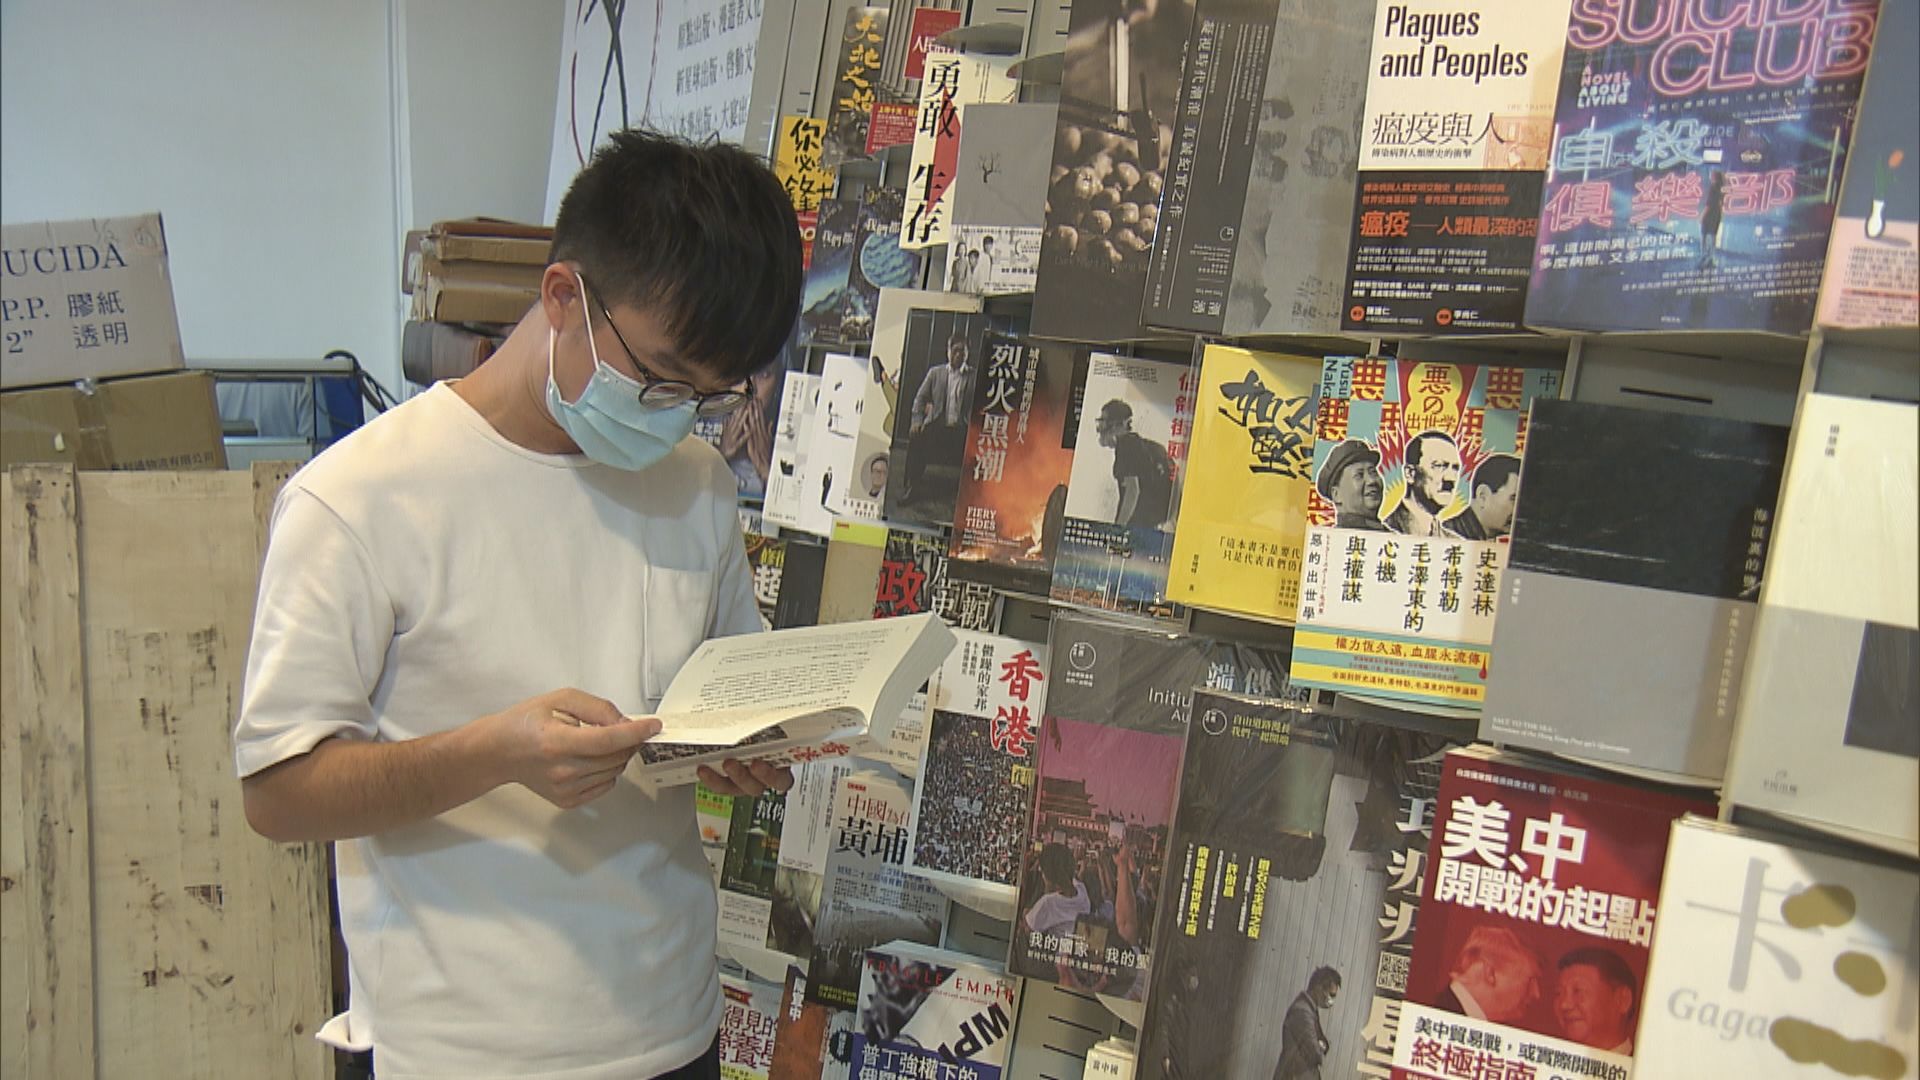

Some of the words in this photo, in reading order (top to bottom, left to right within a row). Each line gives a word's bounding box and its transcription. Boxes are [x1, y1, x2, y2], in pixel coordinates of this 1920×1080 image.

[1385, 6, 1480, 44] Plagues
[1380, 44, 1425, 77] and
[1432, 45, 1528, 85] Peoples
[1651, 16, 1876, 96] CLUB
[921, 59, 961, 139] 勇敢
[1579, 82, 1631, 98] ABOUT
[1581, 72, 1629, 87] NOVEL
[1577, 95, 1628, 109] LIVING
[1372, 111, 1505, 147] 瘟疫與人
[905, 164, 944, 244] 生存
[1545, 170, 1797, 234] 俱樂部
[0, 243, 127, 279] UCIDA
[67, 290, 126, 319] 膠紙
[73, 321, 129, 350] 透明
[973, 343, 1024, 482] 烈火黑潮
[965, 517, 996, 532] TIDES
[967, 505, 997, 520] FIERY
[1222, 549, 1301, 573] 只是代表我們仍
[1341, 535, 1367, 604] 與權謀
[1374, 539, 1400, 584] 心機
[1437, 543, 1465, 614] 希特勒
[1470, 547, 1499, 617] 史達林
[1403, 542, 1432, 633] 毛澤東的
[990, 647, 1045, 757] 香港
[1434, 857, 1656, 948] 開戰的起點
[1667, 987, 1770, 1041] Gaga
[862, 1042, 978, 1080] 普丁強權下的
